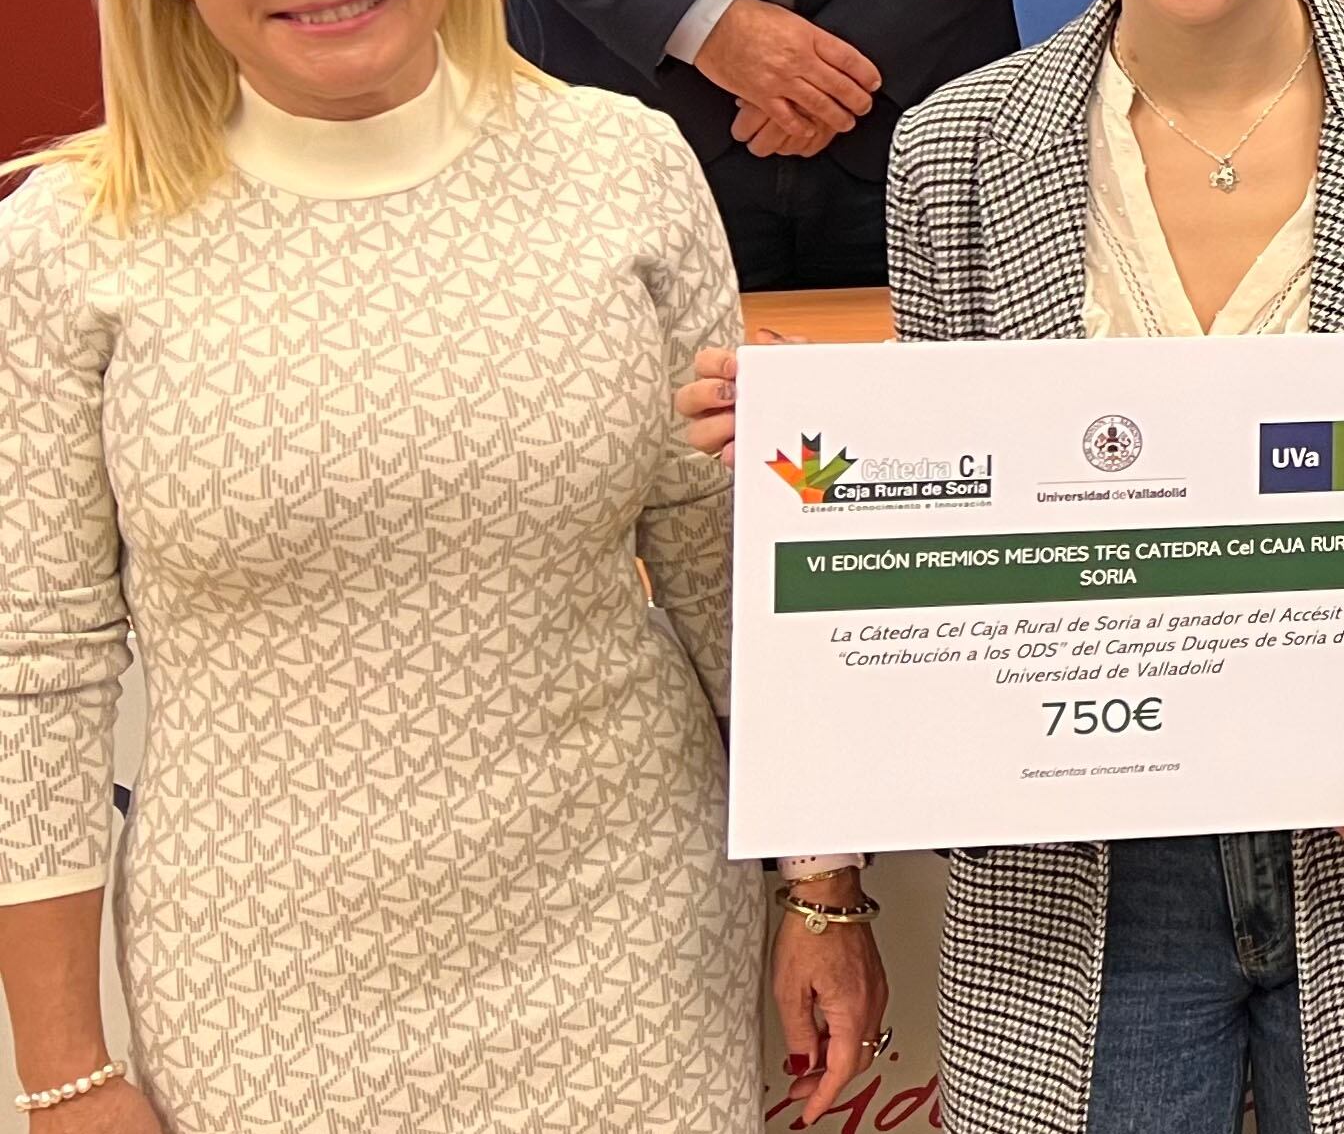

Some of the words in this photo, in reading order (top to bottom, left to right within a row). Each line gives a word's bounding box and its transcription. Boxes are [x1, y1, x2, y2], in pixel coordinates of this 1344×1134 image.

[1272, 447, 1320, 469] UVa
[806, 555, 826, 572] VI
[831, 549, 910, 572] EDICIÓN
[915, 548, 1000, 568] PREMIOS
[1004, 545, 1090, 565] MEJORES
[1093, 543, 1131, 561] TFG
[1134, 540, 1222, 560] CATEDRA
[1259, 536, 1306, 555] CAJA
[1079, 567, 1137, 586] SORIA
[830, 627, 853, 643] La
[859, 624, 930, 642] Cátedra
[970, 621, 1009, 641] Caja
[1014, 617, 1064, 635] Rural
[1066, 616, 1090, 632] de
[1094, 615, 1141, 632] Soria
[1145, 613, 1165, 629] al
[1166, 610, 1244, 632] ganador
[1247, 608, 1277, 624] del
[1278, 606, 1344, 623] Accésit
[966, 649, 978, 662] a
[983, 645, 1011, 660] los
[1071, 640, 1101, 657] del
[1105, 639, 1177, 658] Campus
[1181, 635, 1250, 654] Duques
[1254, 632, 1278, 648] de
[1281, 631, 1328, 646] Soria
[995, 664, 1103, 685] Universidad
[1106, 663, 1130, 679] de
[1137, 658, 1225, 678] Valladolid
[1041, 696, 1163, 737] 750€
